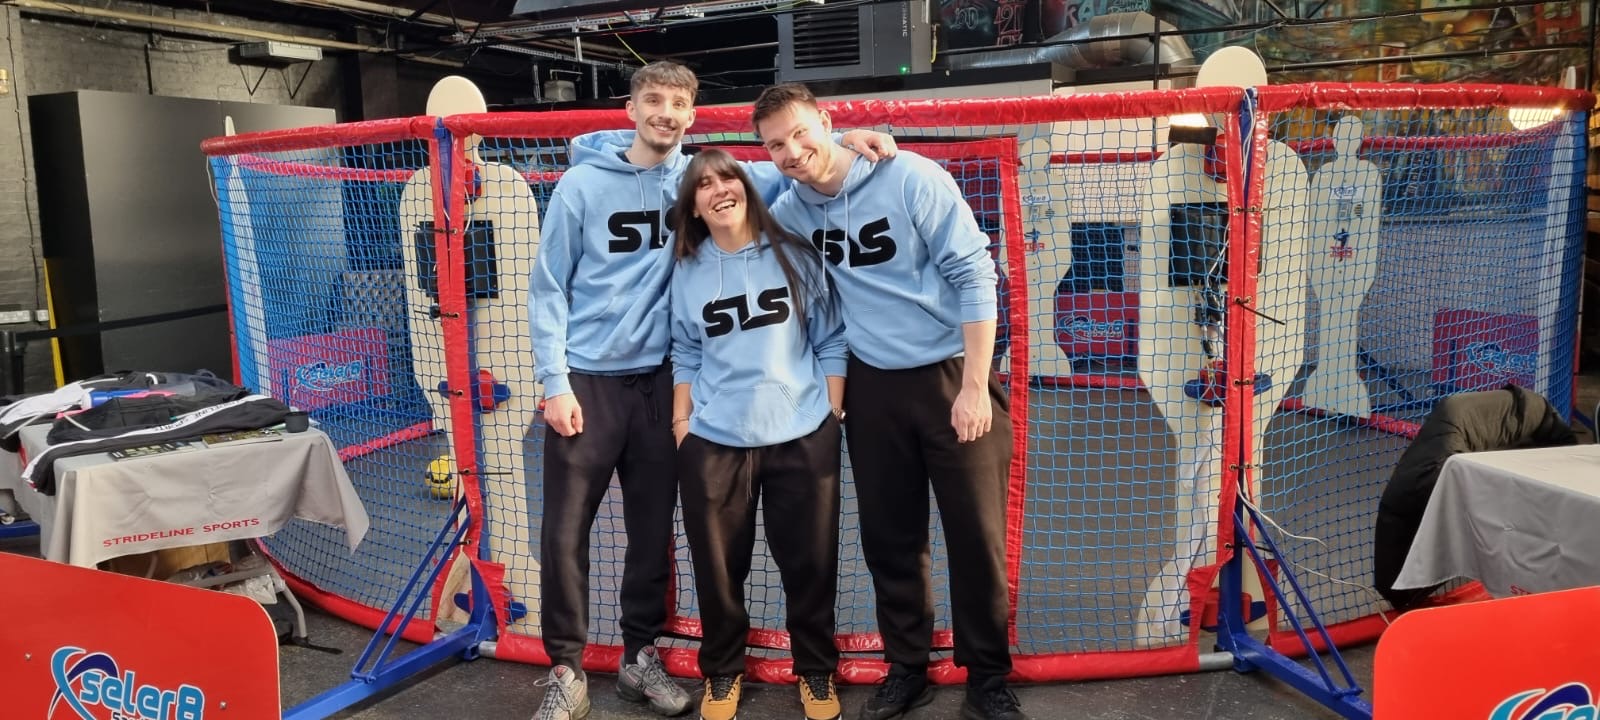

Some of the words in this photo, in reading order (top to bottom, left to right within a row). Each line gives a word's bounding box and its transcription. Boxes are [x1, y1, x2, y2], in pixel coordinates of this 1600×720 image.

[808, 216, 897, 267] SLS
[702, 286, 790, 338] SLS
[103, 527, 194, 548] STRIDELINE
[203, 517, 260, 533] SPORTS
